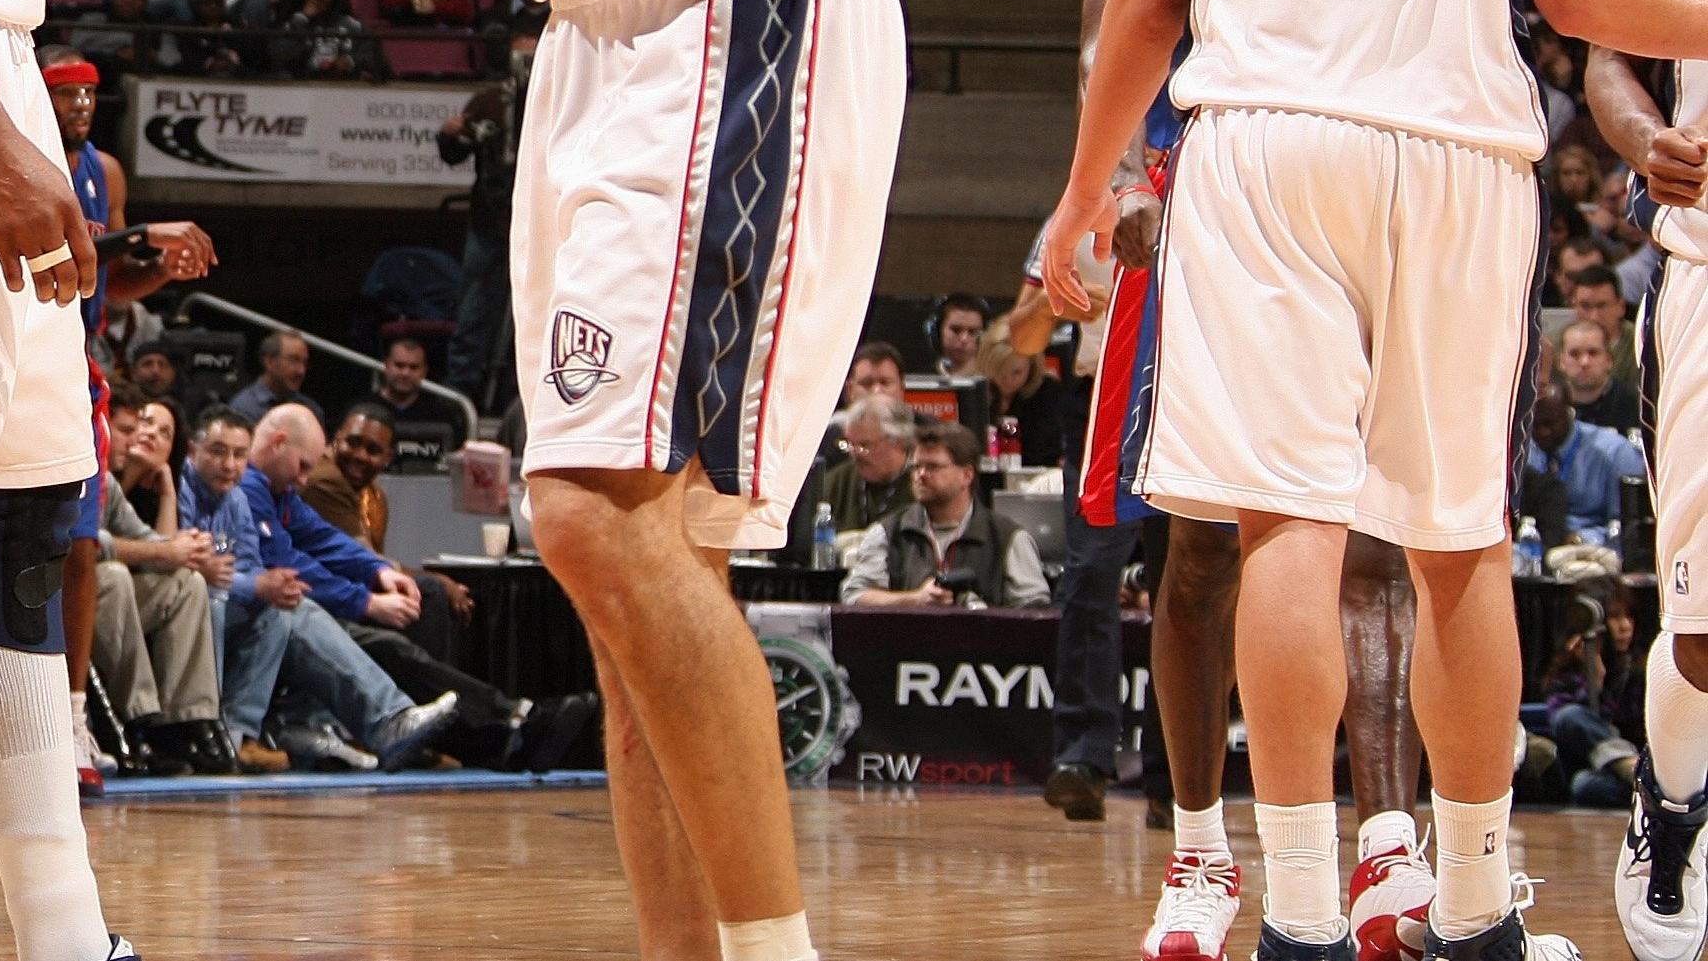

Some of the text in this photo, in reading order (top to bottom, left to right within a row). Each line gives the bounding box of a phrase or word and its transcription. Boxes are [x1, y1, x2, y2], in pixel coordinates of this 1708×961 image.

[155, 90, 247, 114] FLYTE
[214, 114, 307, 137] TYME
[326, 152, 397, 175] Serving
[557, 312, 610, 367] NETS
[398, 441, 441, 457] PNY
